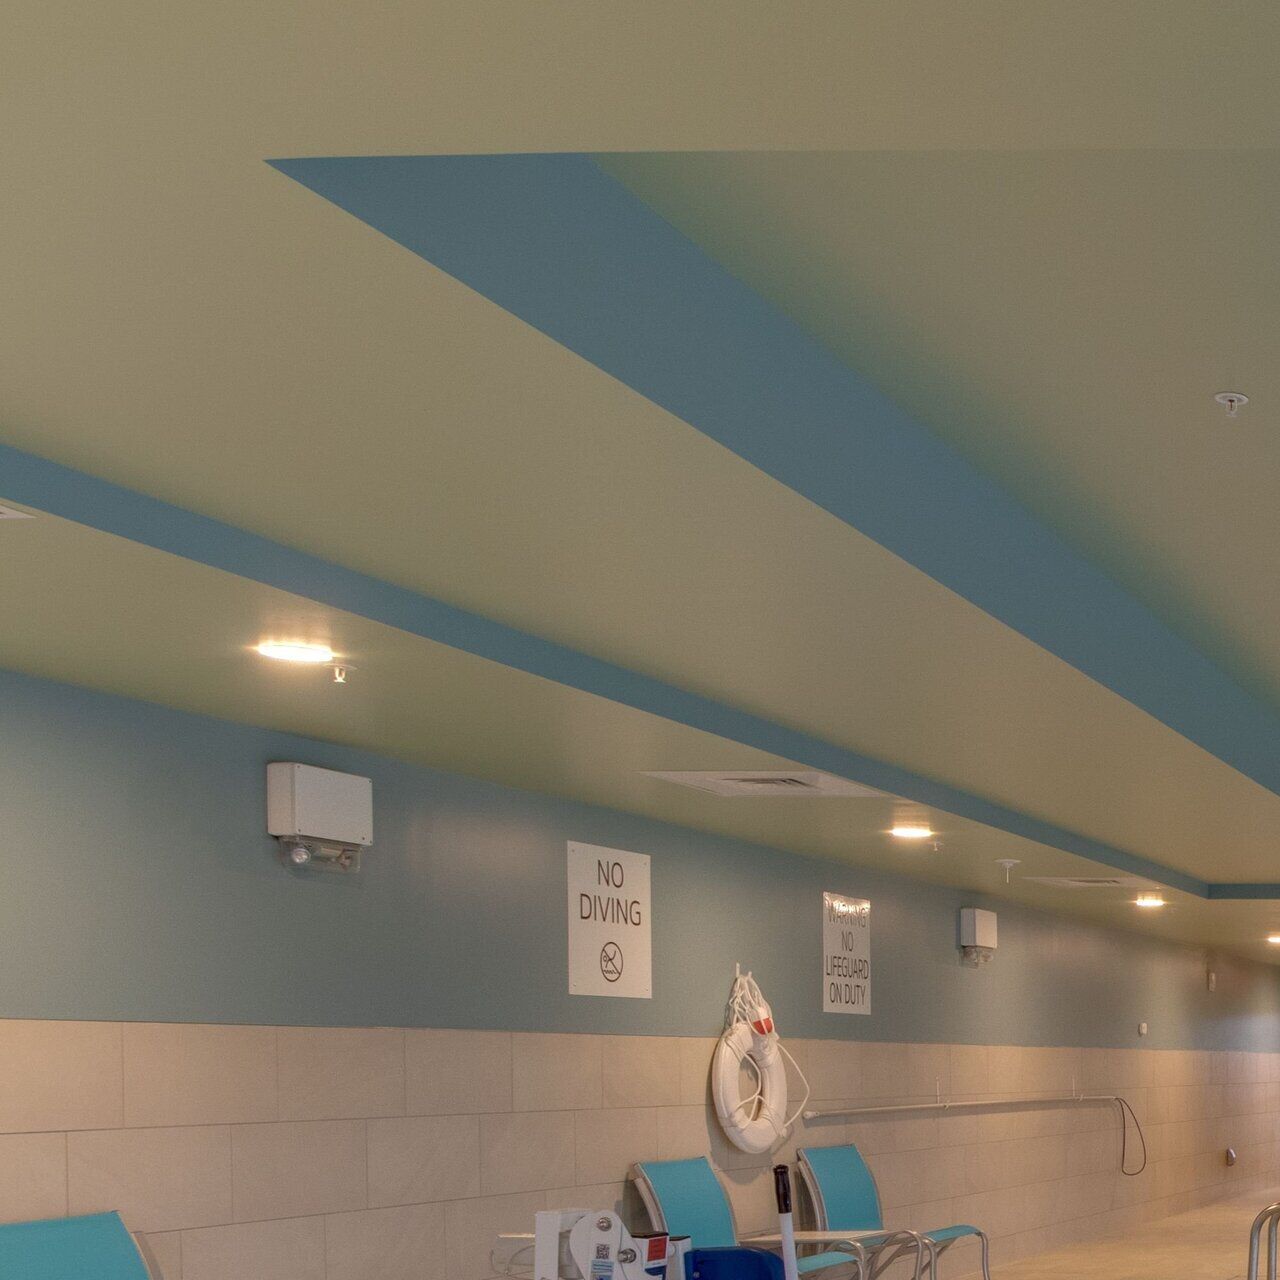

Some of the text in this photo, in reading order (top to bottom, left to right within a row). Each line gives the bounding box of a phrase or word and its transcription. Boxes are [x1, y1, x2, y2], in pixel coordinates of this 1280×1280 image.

[597, 859, 624, 889] NO
[579, 893, 642, 926] DIVING
[841, 931, 855, 952] NO
[825, 955, 869, 980] LIFEGUARD
[829, 982, 866, 1005] ON DUTY
